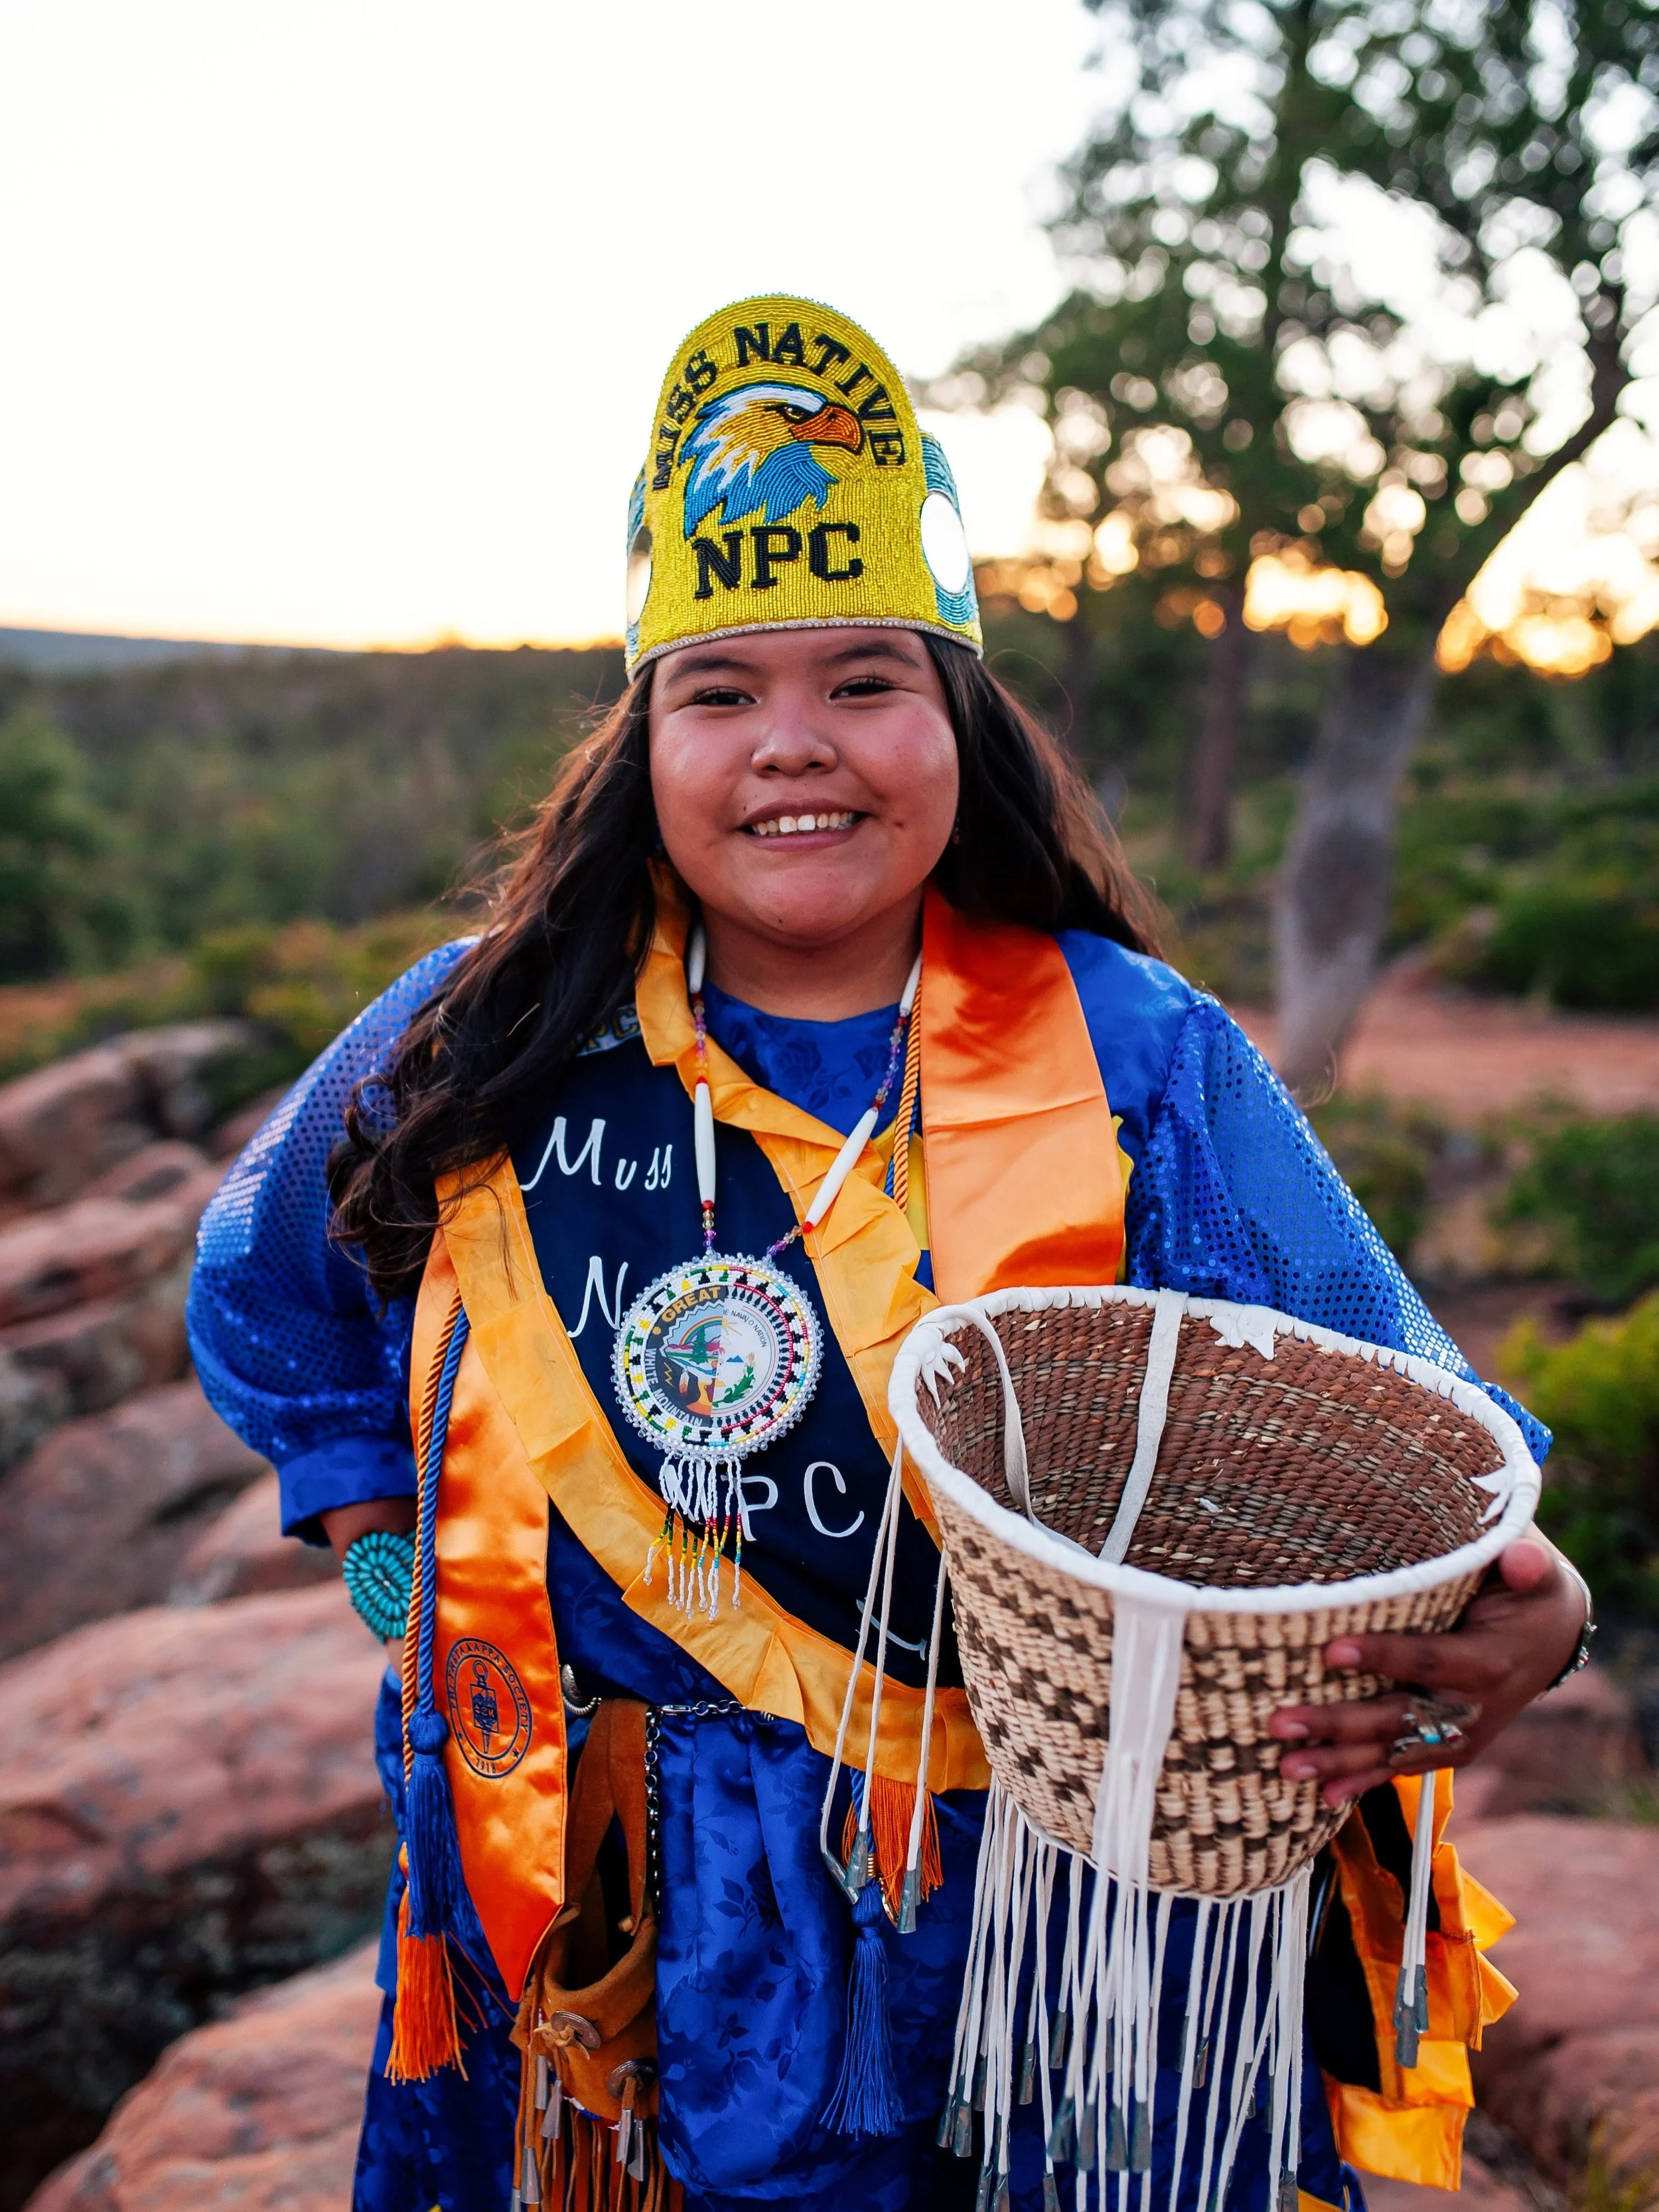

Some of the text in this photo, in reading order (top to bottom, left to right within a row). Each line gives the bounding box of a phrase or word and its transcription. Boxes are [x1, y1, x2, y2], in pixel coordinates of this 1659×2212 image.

[653, 322, 906, 490] MISS NATIVE
[692, 522, 863, 599] NPC
[661, 1286, 721, 1323] GREAT
[731, 1309, 768, 1348] NAVAJO NATION
[644, 1348, 703, 1427] WHITE MOUNTAIN
[465, 1642, 500, 1664] KAPPA
[502, 1666, 529, 1733] SOCIETY
[476, 1758, 496, 1774] 1918
